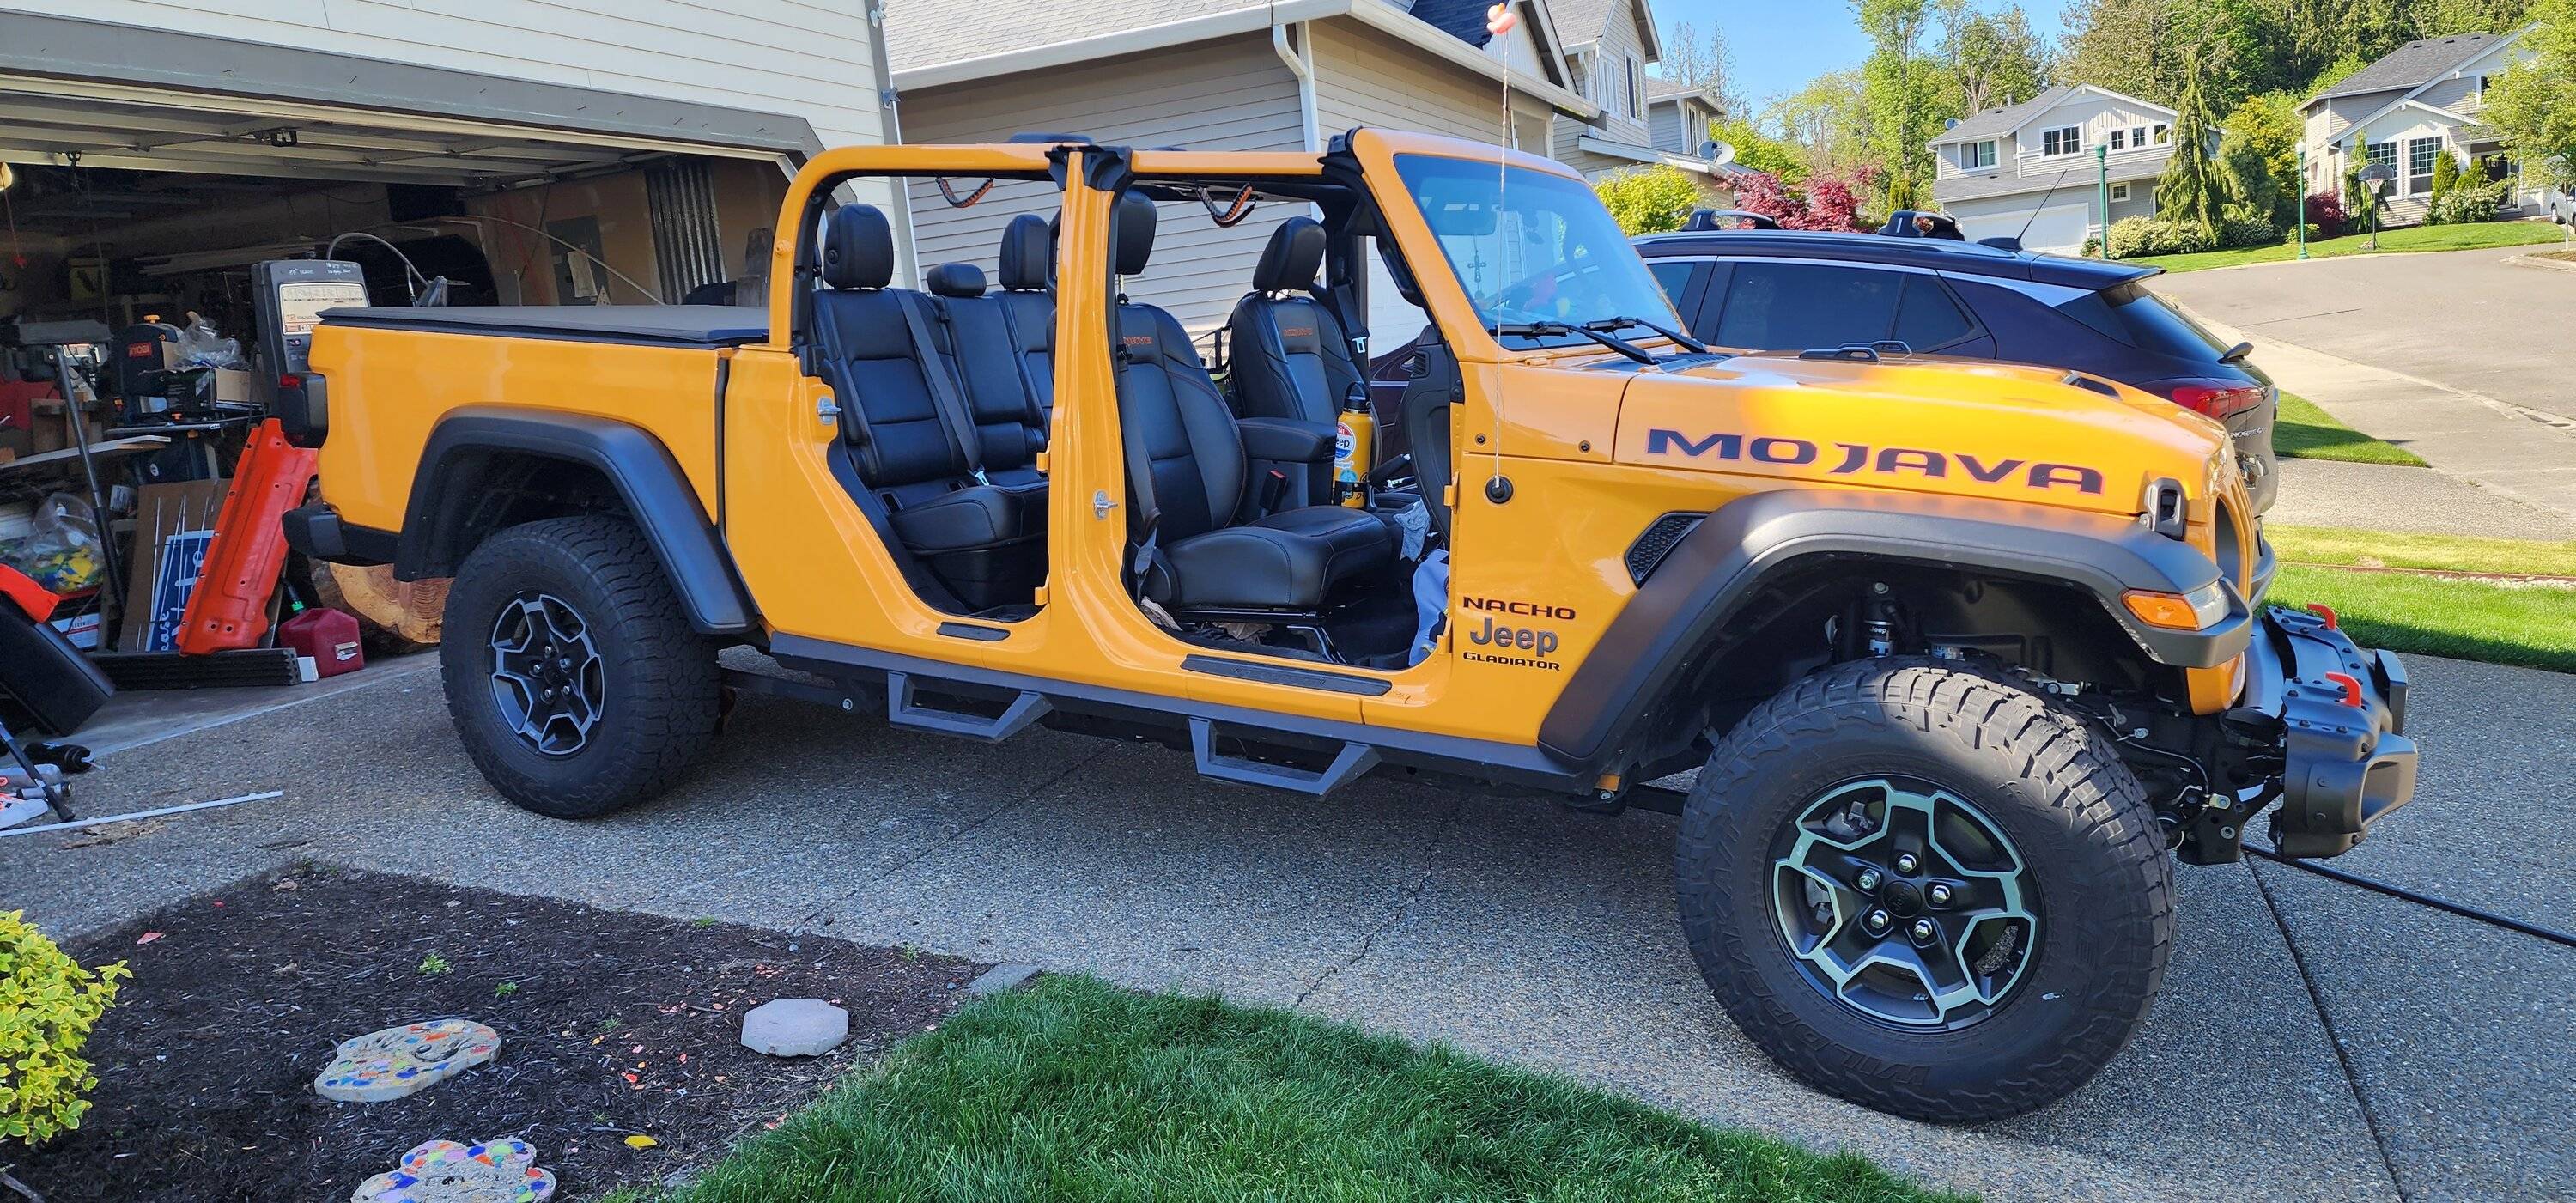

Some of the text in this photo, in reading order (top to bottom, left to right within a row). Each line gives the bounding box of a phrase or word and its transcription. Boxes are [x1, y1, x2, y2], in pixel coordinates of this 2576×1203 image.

[1336, 438, 1350, 448] eep
[1646, 428, 2105, 495] MOJAVA
[1463, 596, 1577, 620] NACHO
[1469, 617, 1558, 658] Jeep
[1462, 651, 1561, 671] GLADIATOR
